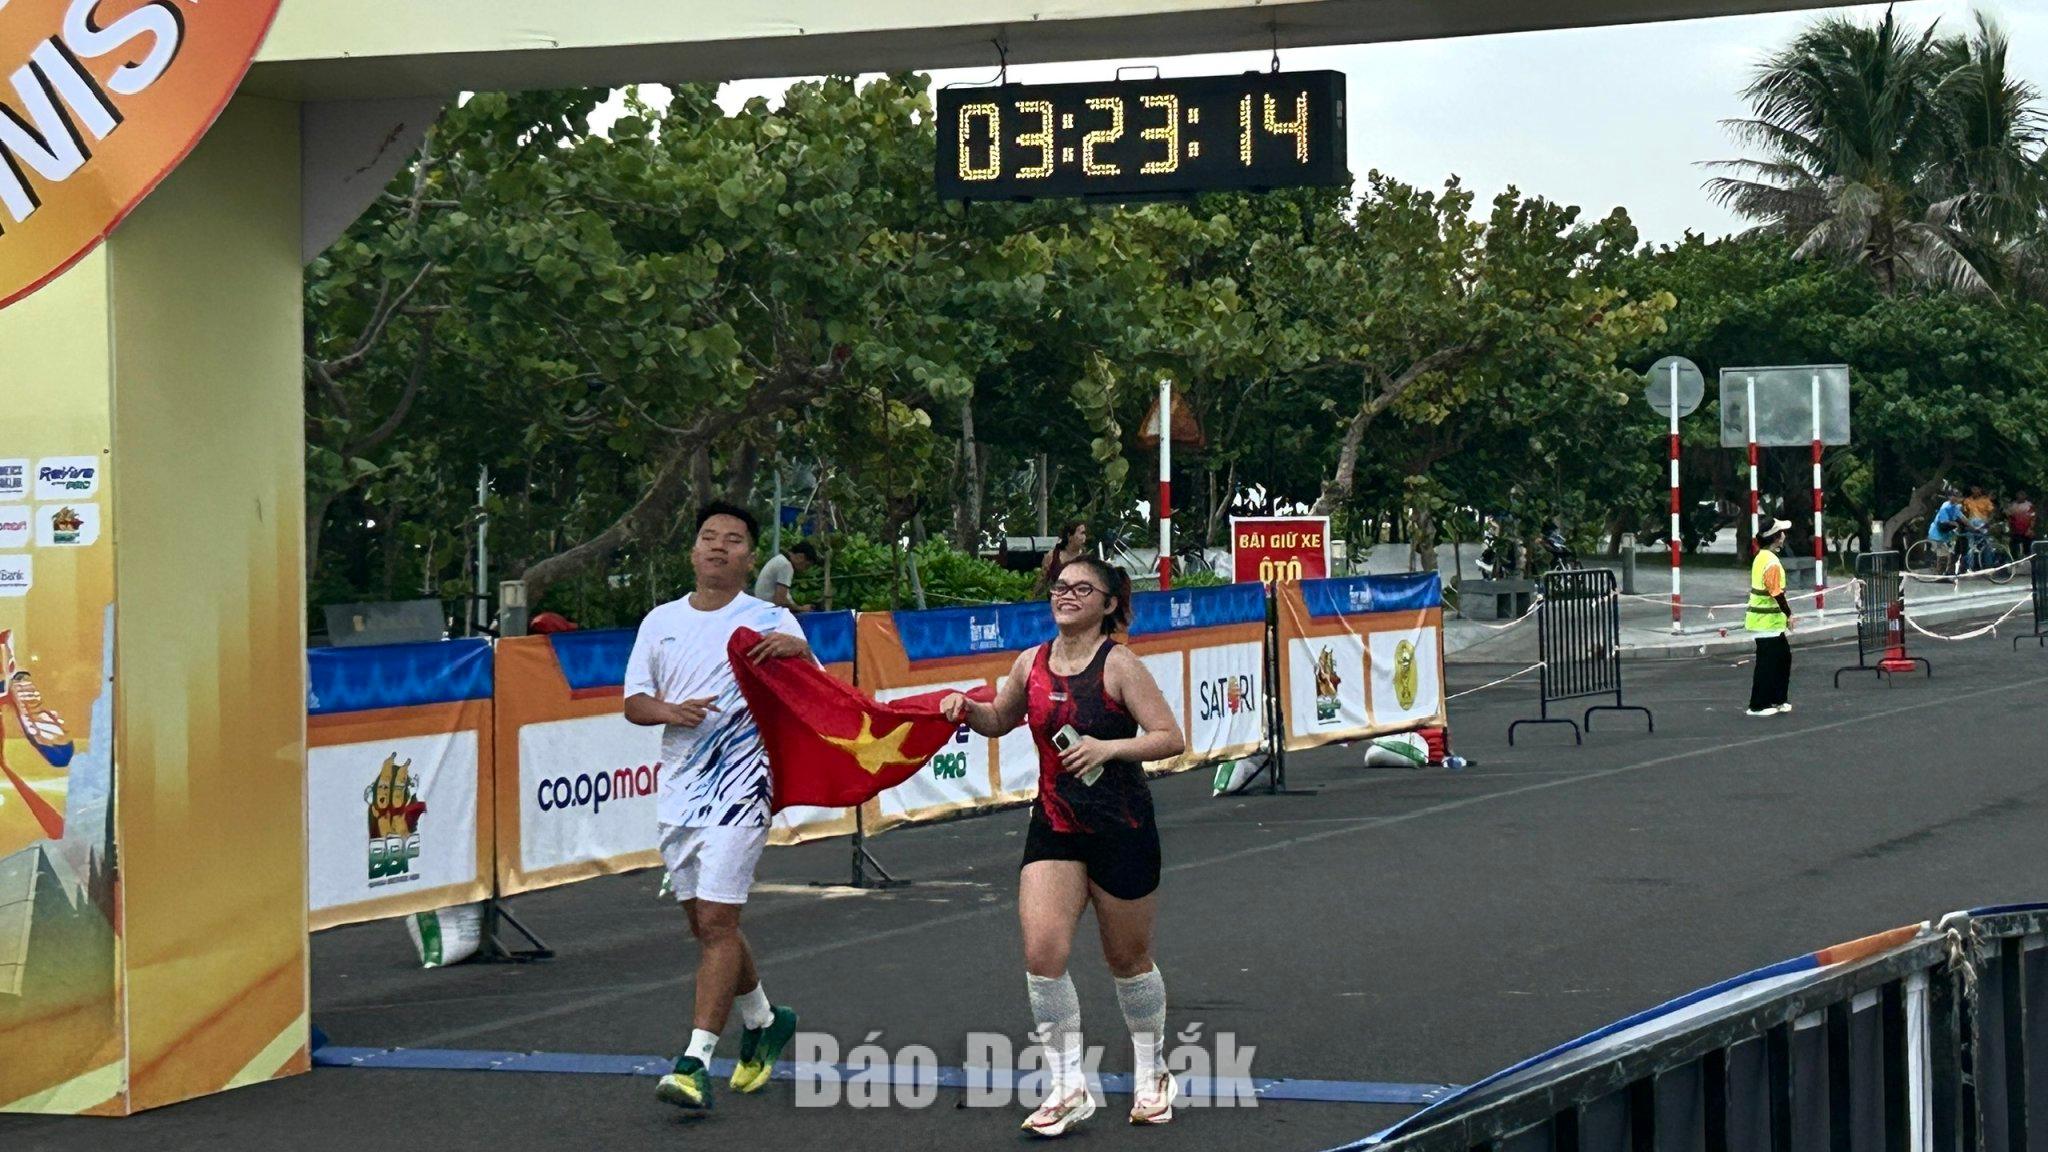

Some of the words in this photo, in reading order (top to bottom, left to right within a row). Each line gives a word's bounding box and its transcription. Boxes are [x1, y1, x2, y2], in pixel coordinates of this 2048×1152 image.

[1240, 532, 1265, 548] BÃI
[1270, 532, 1299, 548] GIỮ
[1301, 534, 1321, 548] XE
